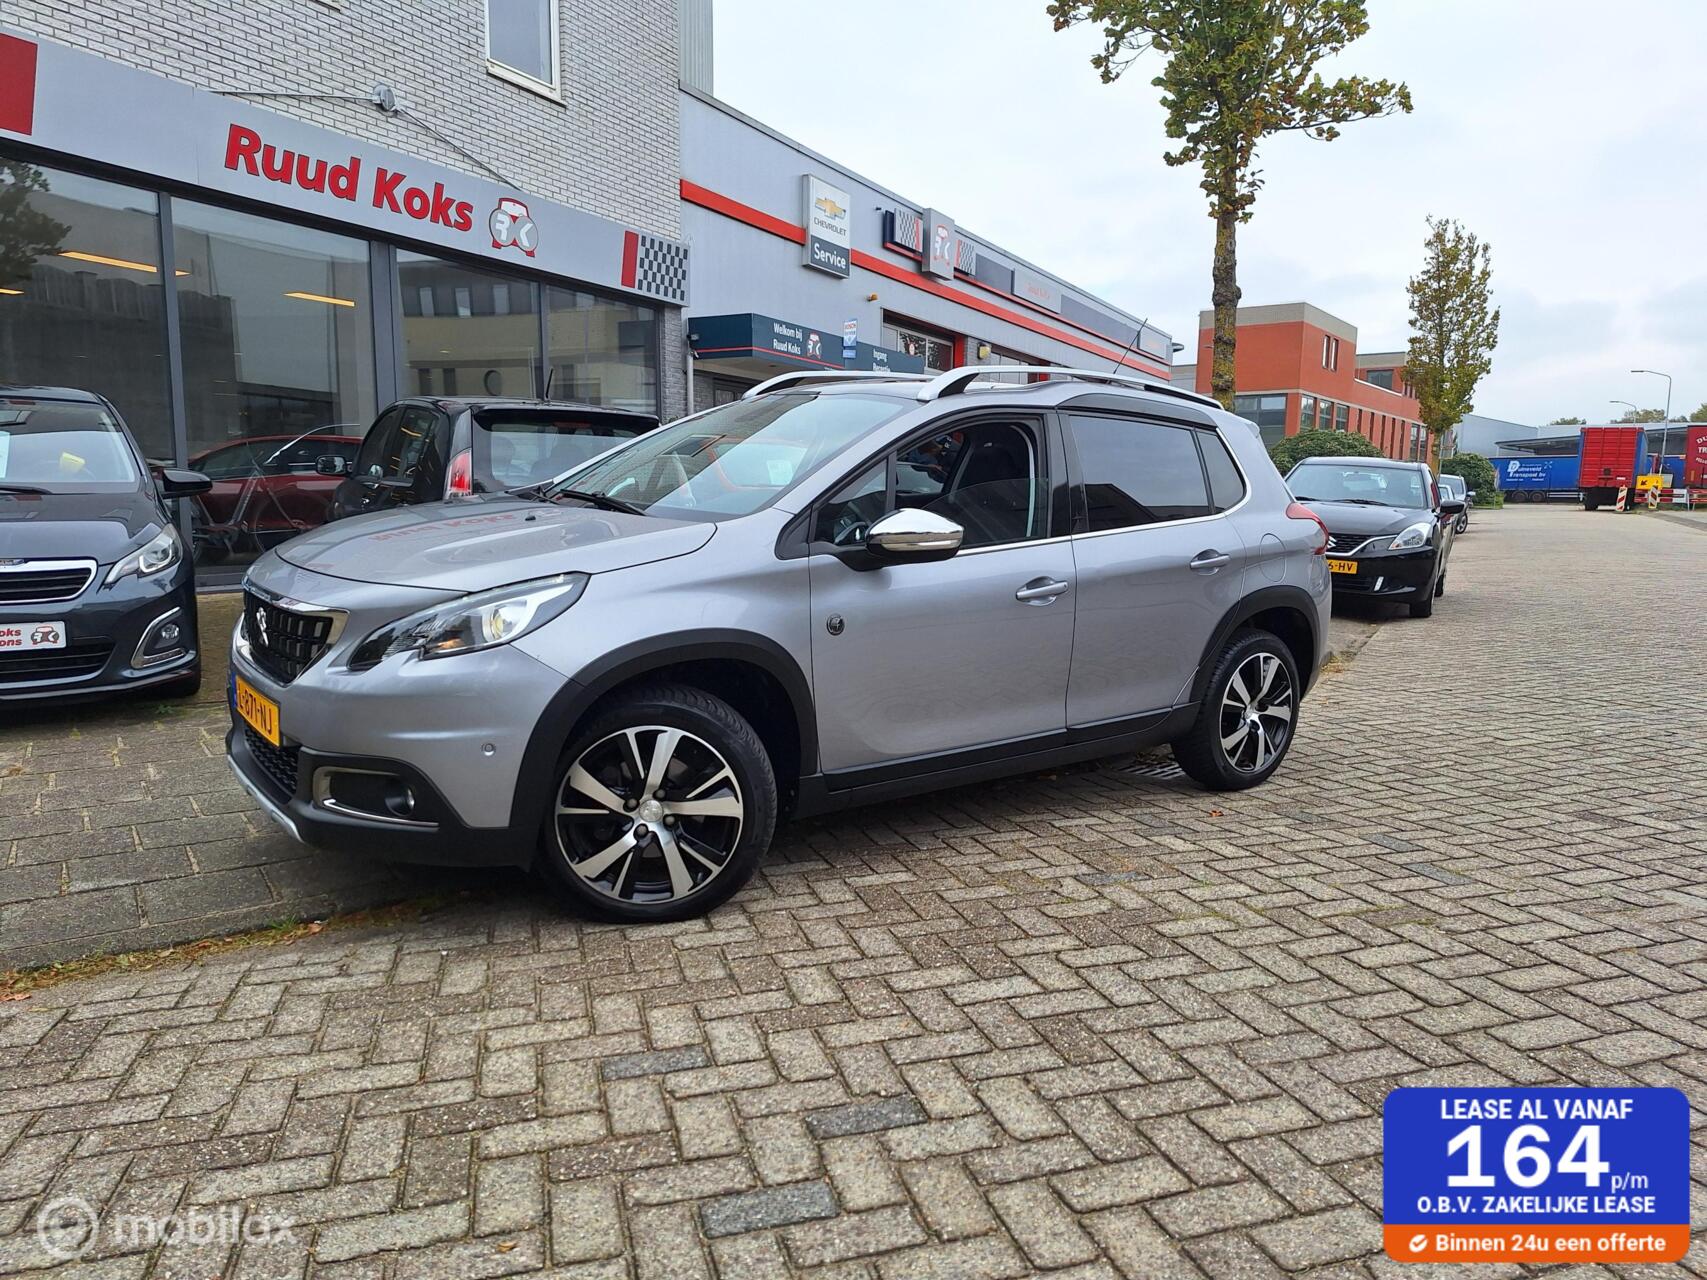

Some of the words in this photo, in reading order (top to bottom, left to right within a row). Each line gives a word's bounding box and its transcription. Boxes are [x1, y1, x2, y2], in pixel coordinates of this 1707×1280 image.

[224, 123, 361, 202] Ruud
[372, 167, 474, 232] Koks
[813, 216, 847, 237] CHEVROLET
[813, 242, 847, 270] Service
[773, 322, 796, 338] Welkom
[795, 327, 803, 342] bij
[773, 338, 788, 352] Ruud
[787, 342, 801, 355] Koks
[873, 348, 888, 362] Ingang
